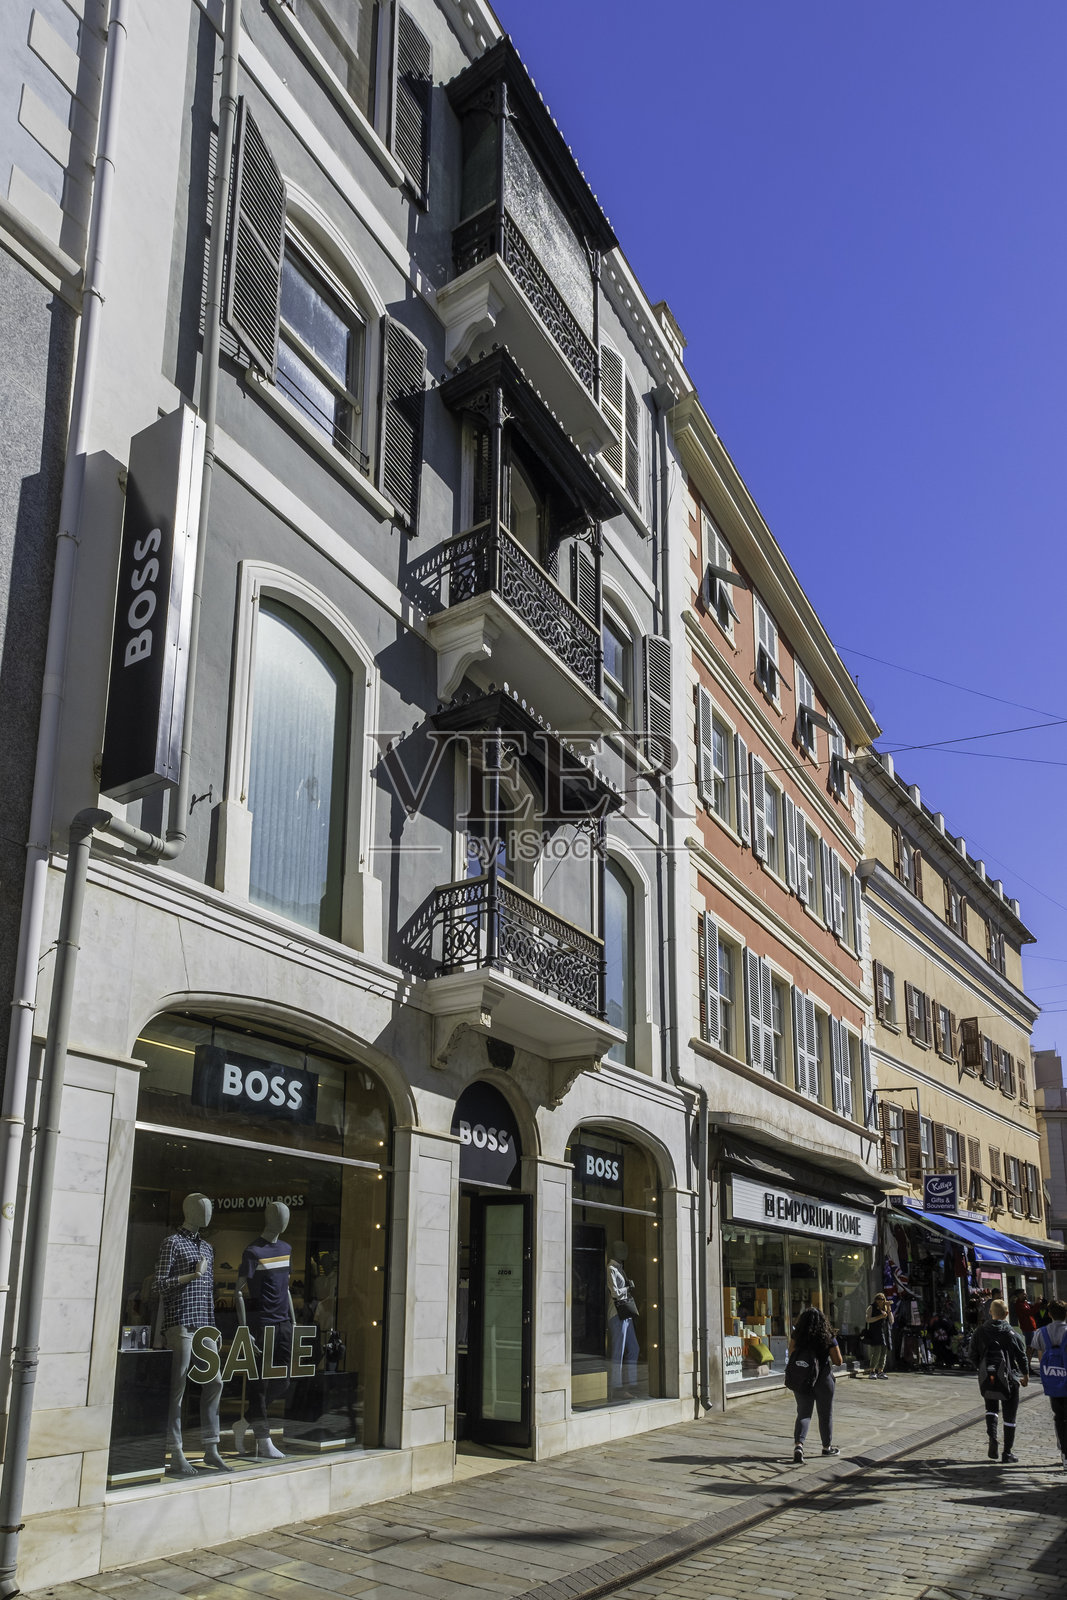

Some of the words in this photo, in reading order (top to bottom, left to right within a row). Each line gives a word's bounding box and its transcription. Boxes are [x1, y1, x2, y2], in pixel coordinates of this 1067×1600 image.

[123, 527, 162, 668] BOSS
[222, 1062, 303, 1111] BOSS
[459, 1120, 509, 1154] BOSS
[586, 1154, 619, 1181] BOSS
[217, 1198, 245, 1209] YOUR
[777, 1197, 834, 1231] EMPORIUM
[836, 1212, 862, 1236] HOME
[187, 1325, 318, 1384] SALE
